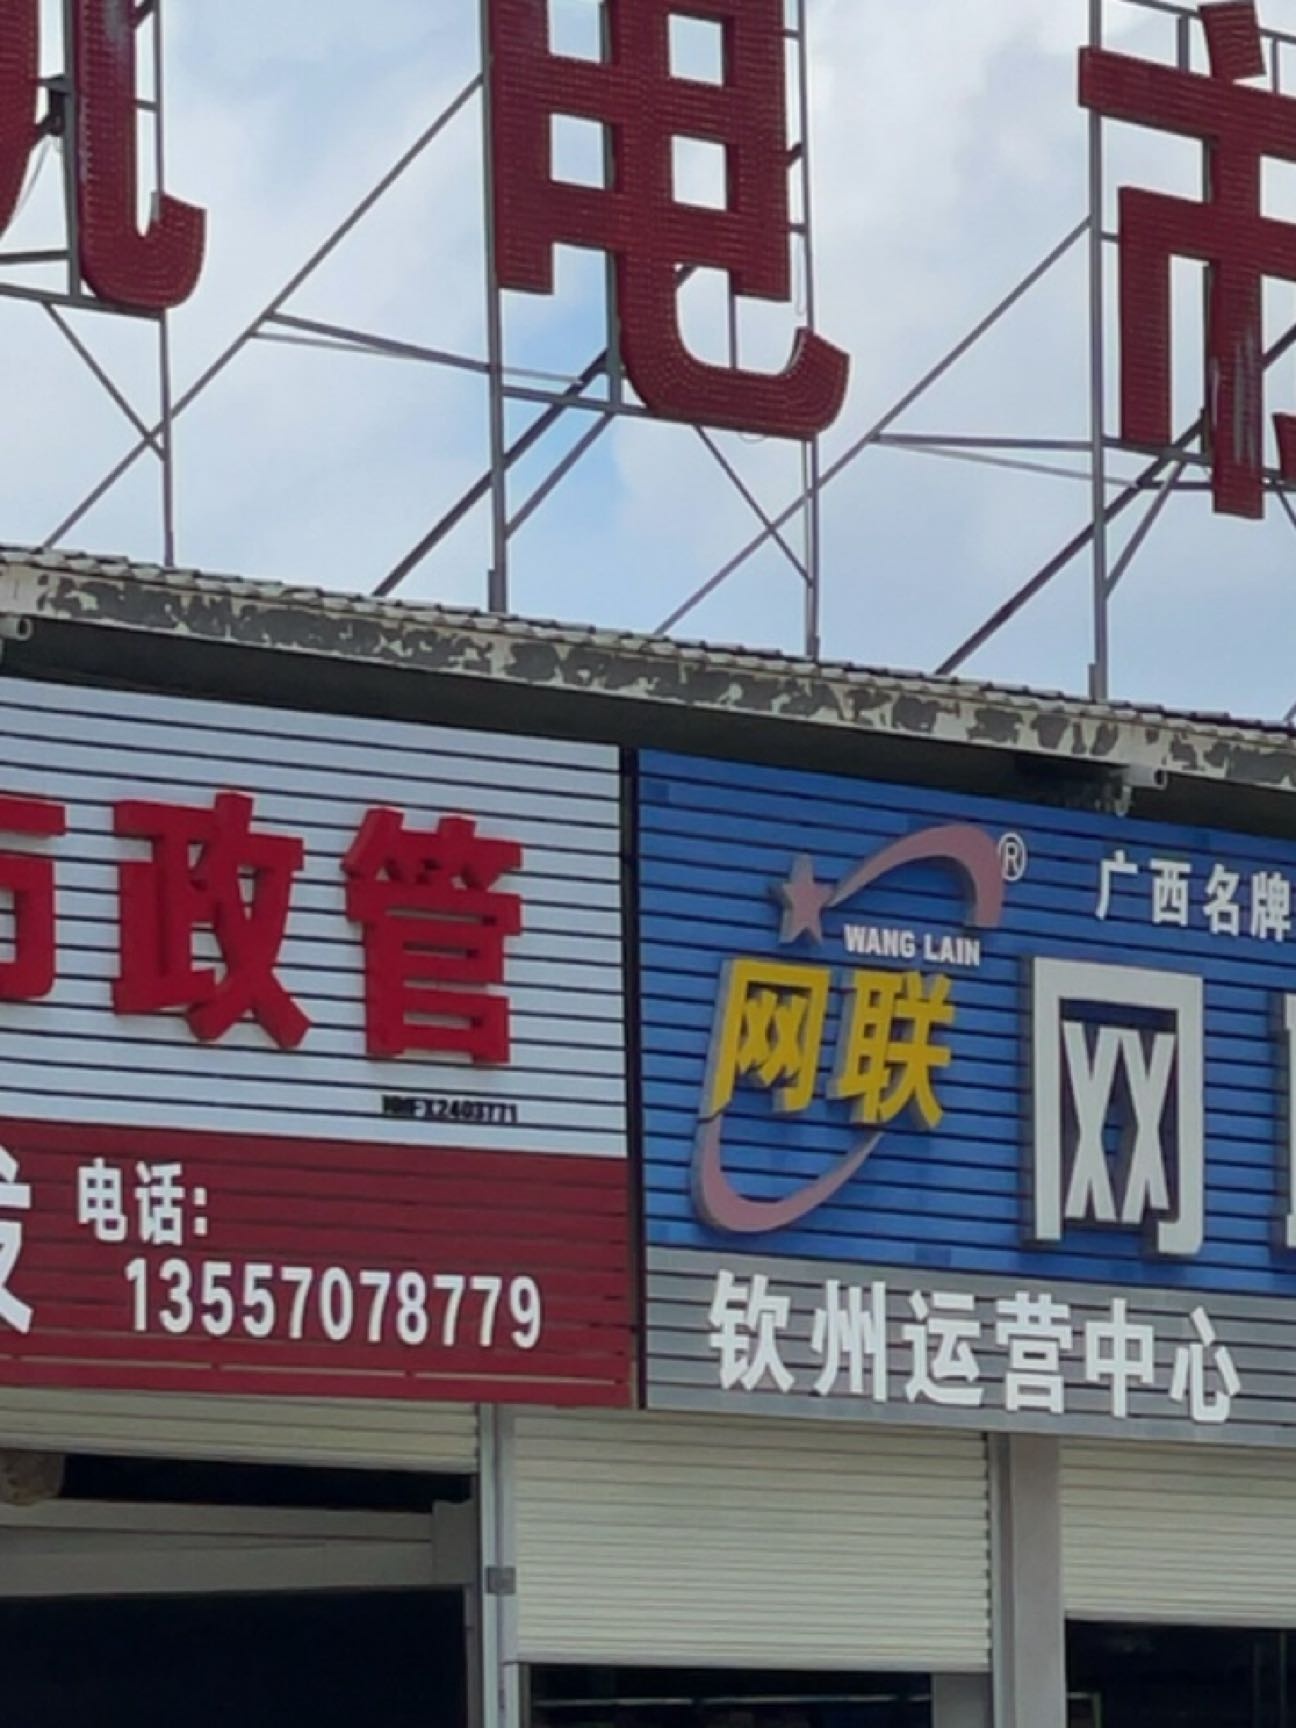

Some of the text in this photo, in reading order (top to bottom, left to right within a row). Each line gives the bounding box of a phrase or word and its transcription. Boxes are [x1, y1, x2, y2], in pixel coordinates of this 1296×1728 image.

[844, 924, 981, 966] WANG LAIN
[706, 958, 955, 1129] 网联
[125, 1257, 541, 1350] 13557078779
[707, 1269, 1241, 1424] 钦州运营中心
